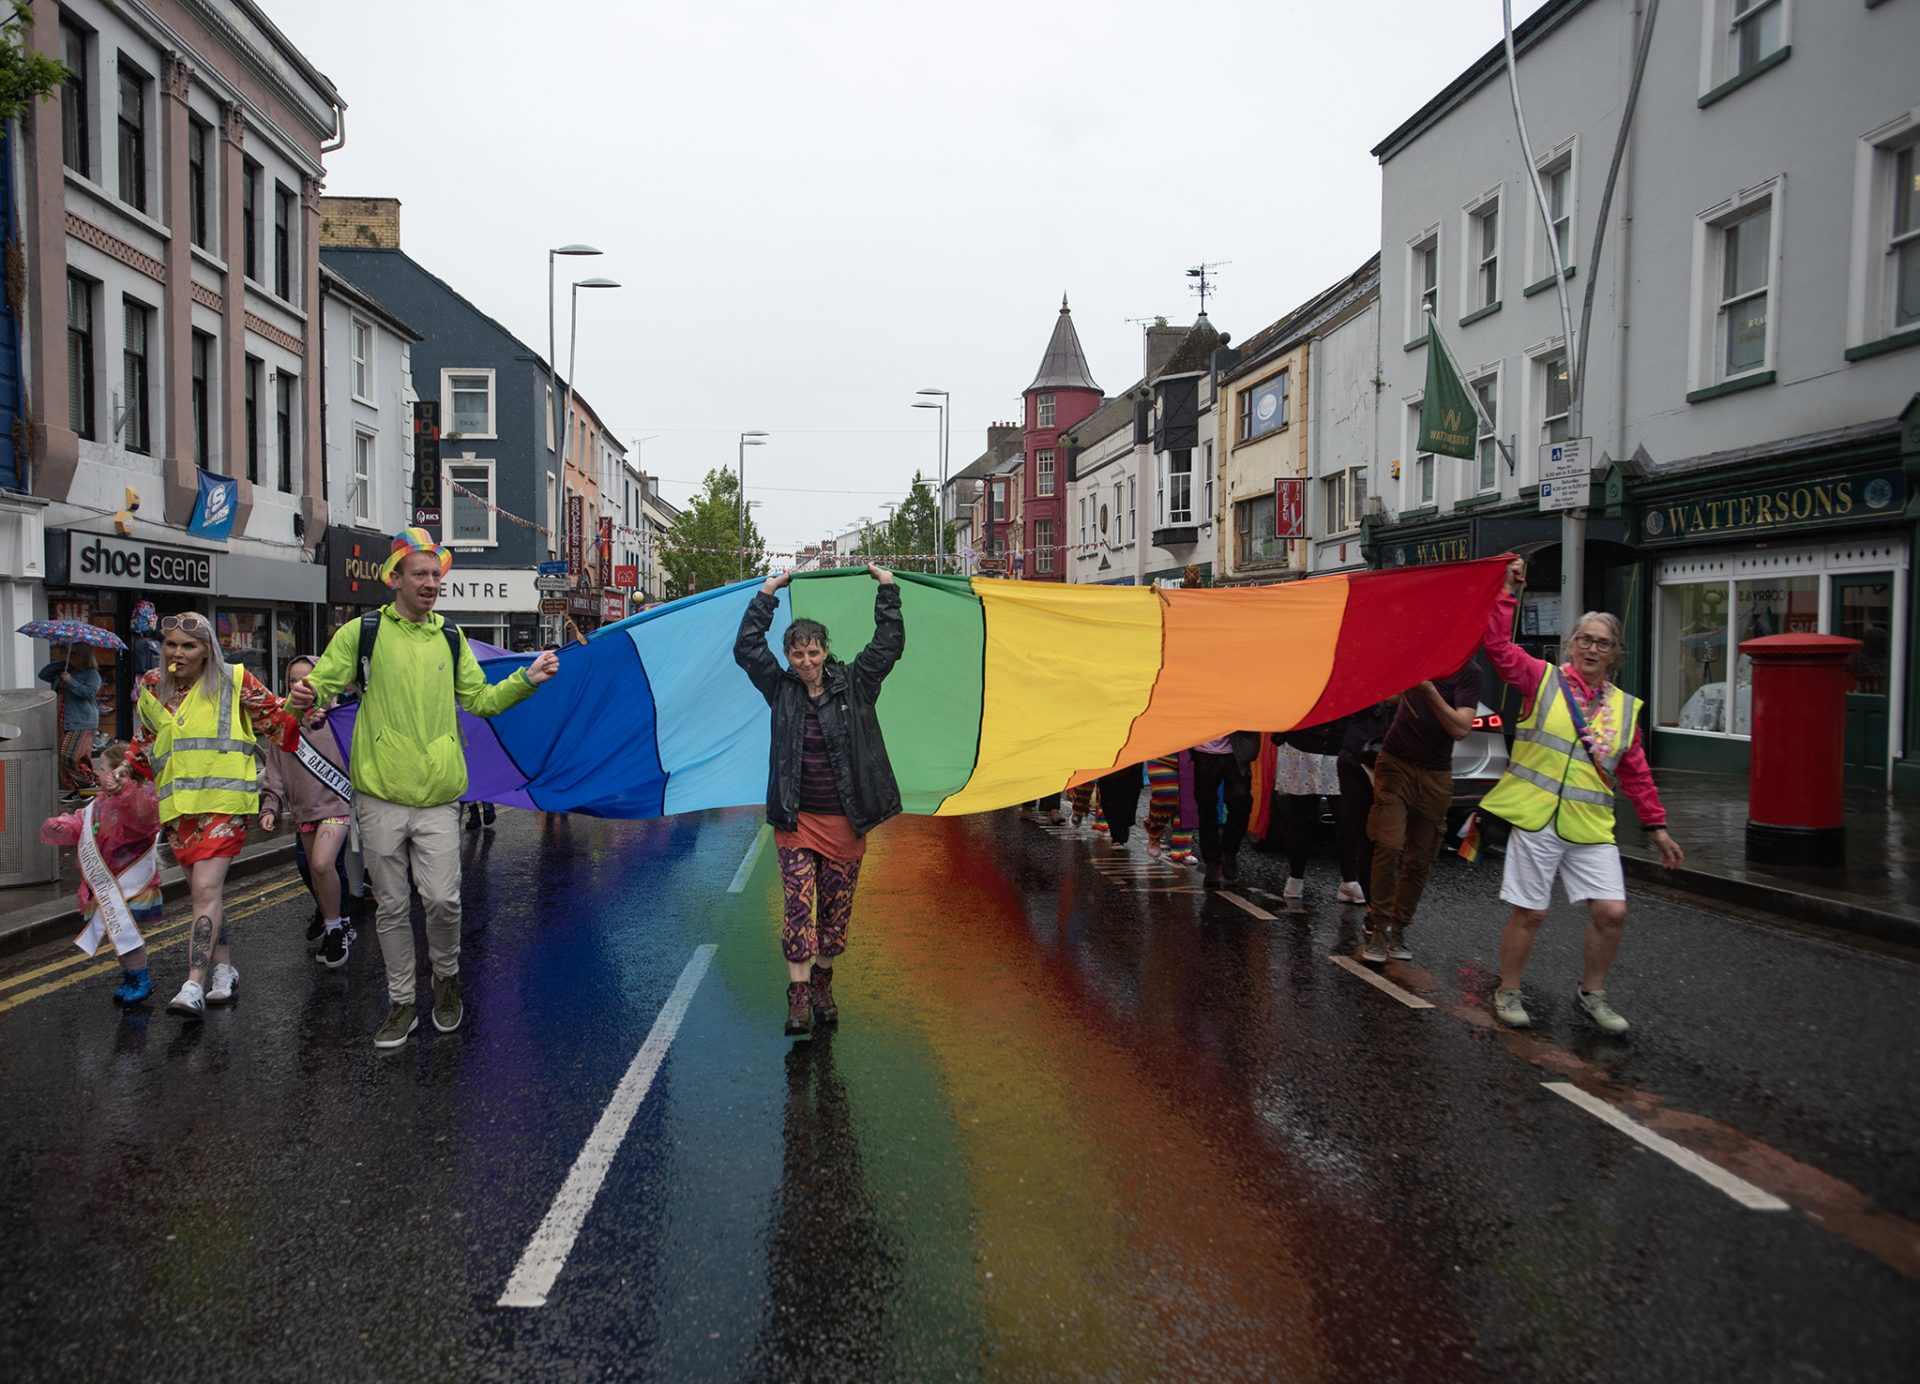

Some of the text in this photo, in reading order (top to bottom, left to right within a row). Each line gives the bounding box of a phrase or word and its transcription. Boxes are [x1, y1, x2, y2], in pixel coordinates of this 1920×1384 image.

[419, 403, 434, 506] POLLOCK
[1669, 482, 1854, 533] WATTERSONS
[81, 538, 209, 583] shoe scene
[1417, 538, 1469, 564] WATTE
[438, 582, 508, 598] ENTRE
[57, 603, 90, 623] SALE
[308, 755, 345, 787] GALAXY
[80, 848, 98, 884] SHINING
[95, 880, 112, 908] LIGHT
